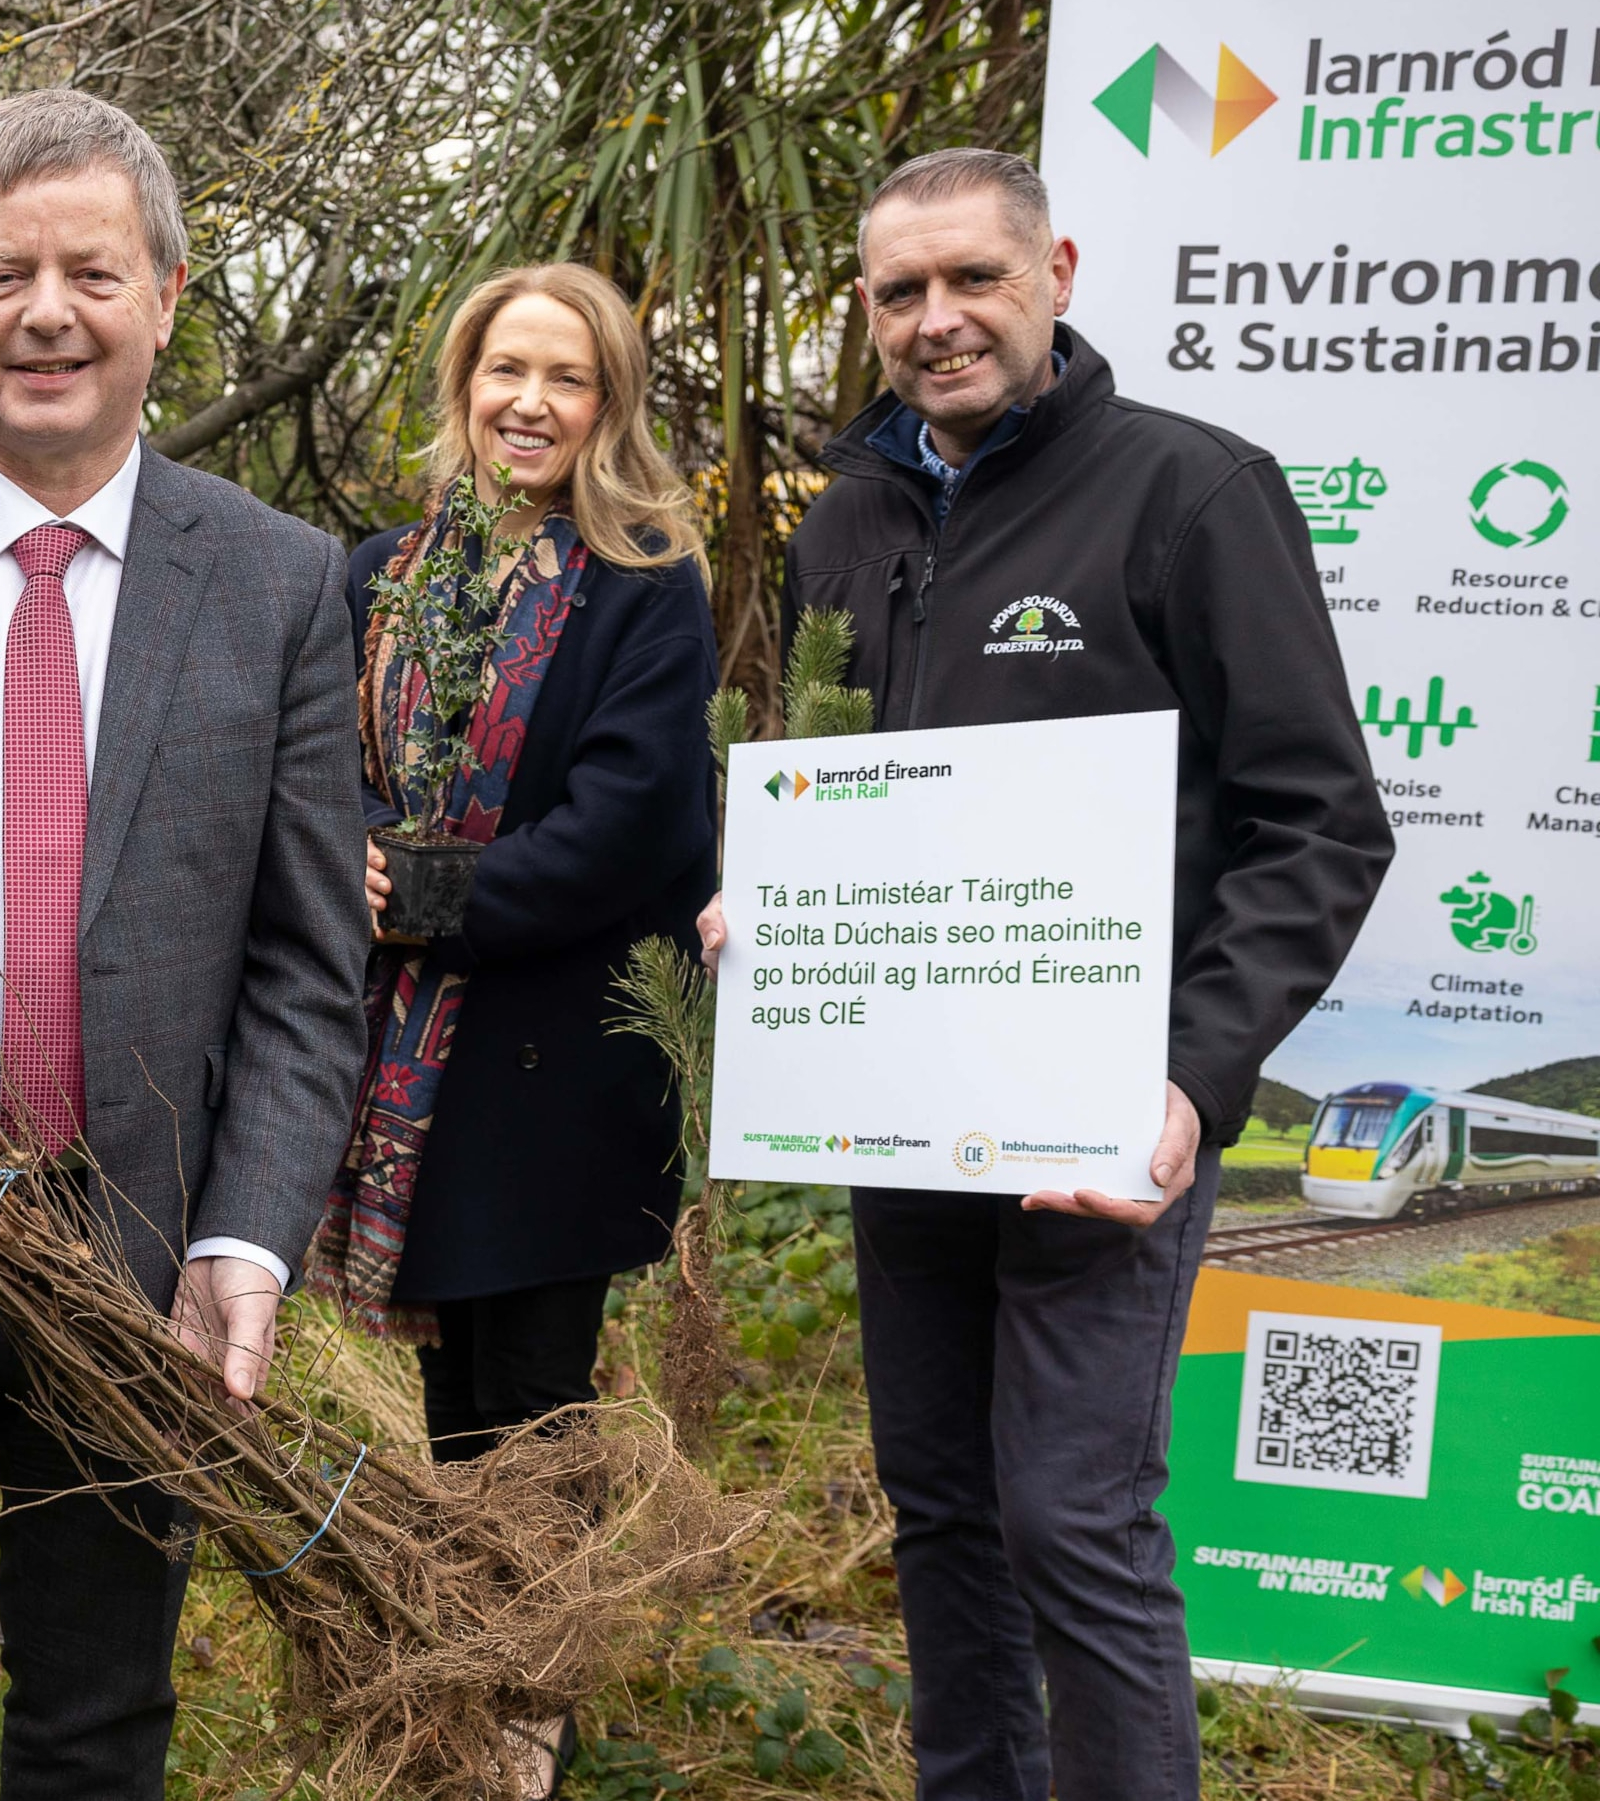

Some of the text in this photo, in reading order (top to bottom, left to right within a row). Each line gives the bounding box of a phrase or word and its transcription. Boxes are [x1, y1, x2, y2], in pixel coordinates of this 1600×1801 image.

[1304, 28, 1569, 96] Iarnród
[1298, 97, 1600, 161] Infrastr
[1167, 322, 1216, 373] &
[1451, 569, 1569, 589] Resource
[1416, 596, 1544, 617] Reduction
[1552, 600, 1571, 618] &
[984, 639, 1085, 655] (FORESTRY) LTD.
[816, 760, 952, 785] Iarnród Éireann
[815, 782, 888, 801] Irish Rail
[1376, 778, 1442, 798] Noise
[1385, 809, 1484, 828] gement
[757, 876, 1074, 908] Tá an Limistéar Táirgthe
[755, 916, 1143, 947] Síolta Dúchais seo maoinithe
[753, 953, 1141, 991] go bródúil ag Iarnród Éireann
[1431, 974, 1524, 996] Climate
[751, 996, 867, 1030] agus CIÉ
[1406, 999, 1542, 1025] Adaptation
[743, 1132, 821, 1144] SUSTAINABILITY
[770, 1142, 820, 1153] IN MOTION
[854, 1134, 930, 1148] Iarnród Éireann
[1002, 1140, 1119, 1156] Inbhuanaitheacht
[854, 1145, 896, 1157] Irish Rail
[965, 1146, 984, 1162] CIE
[1521, 1454, 1600, 1473] SUSTAIN
[1193, 1546, 1393, 1582] SUSTAINABILITY
[1258, 1571, 1387, 1600] IN MOTION
[1473, 1570, 1564, 1600] Iarnród
[1471, 1592, 1574, 1622] Irish Rail
